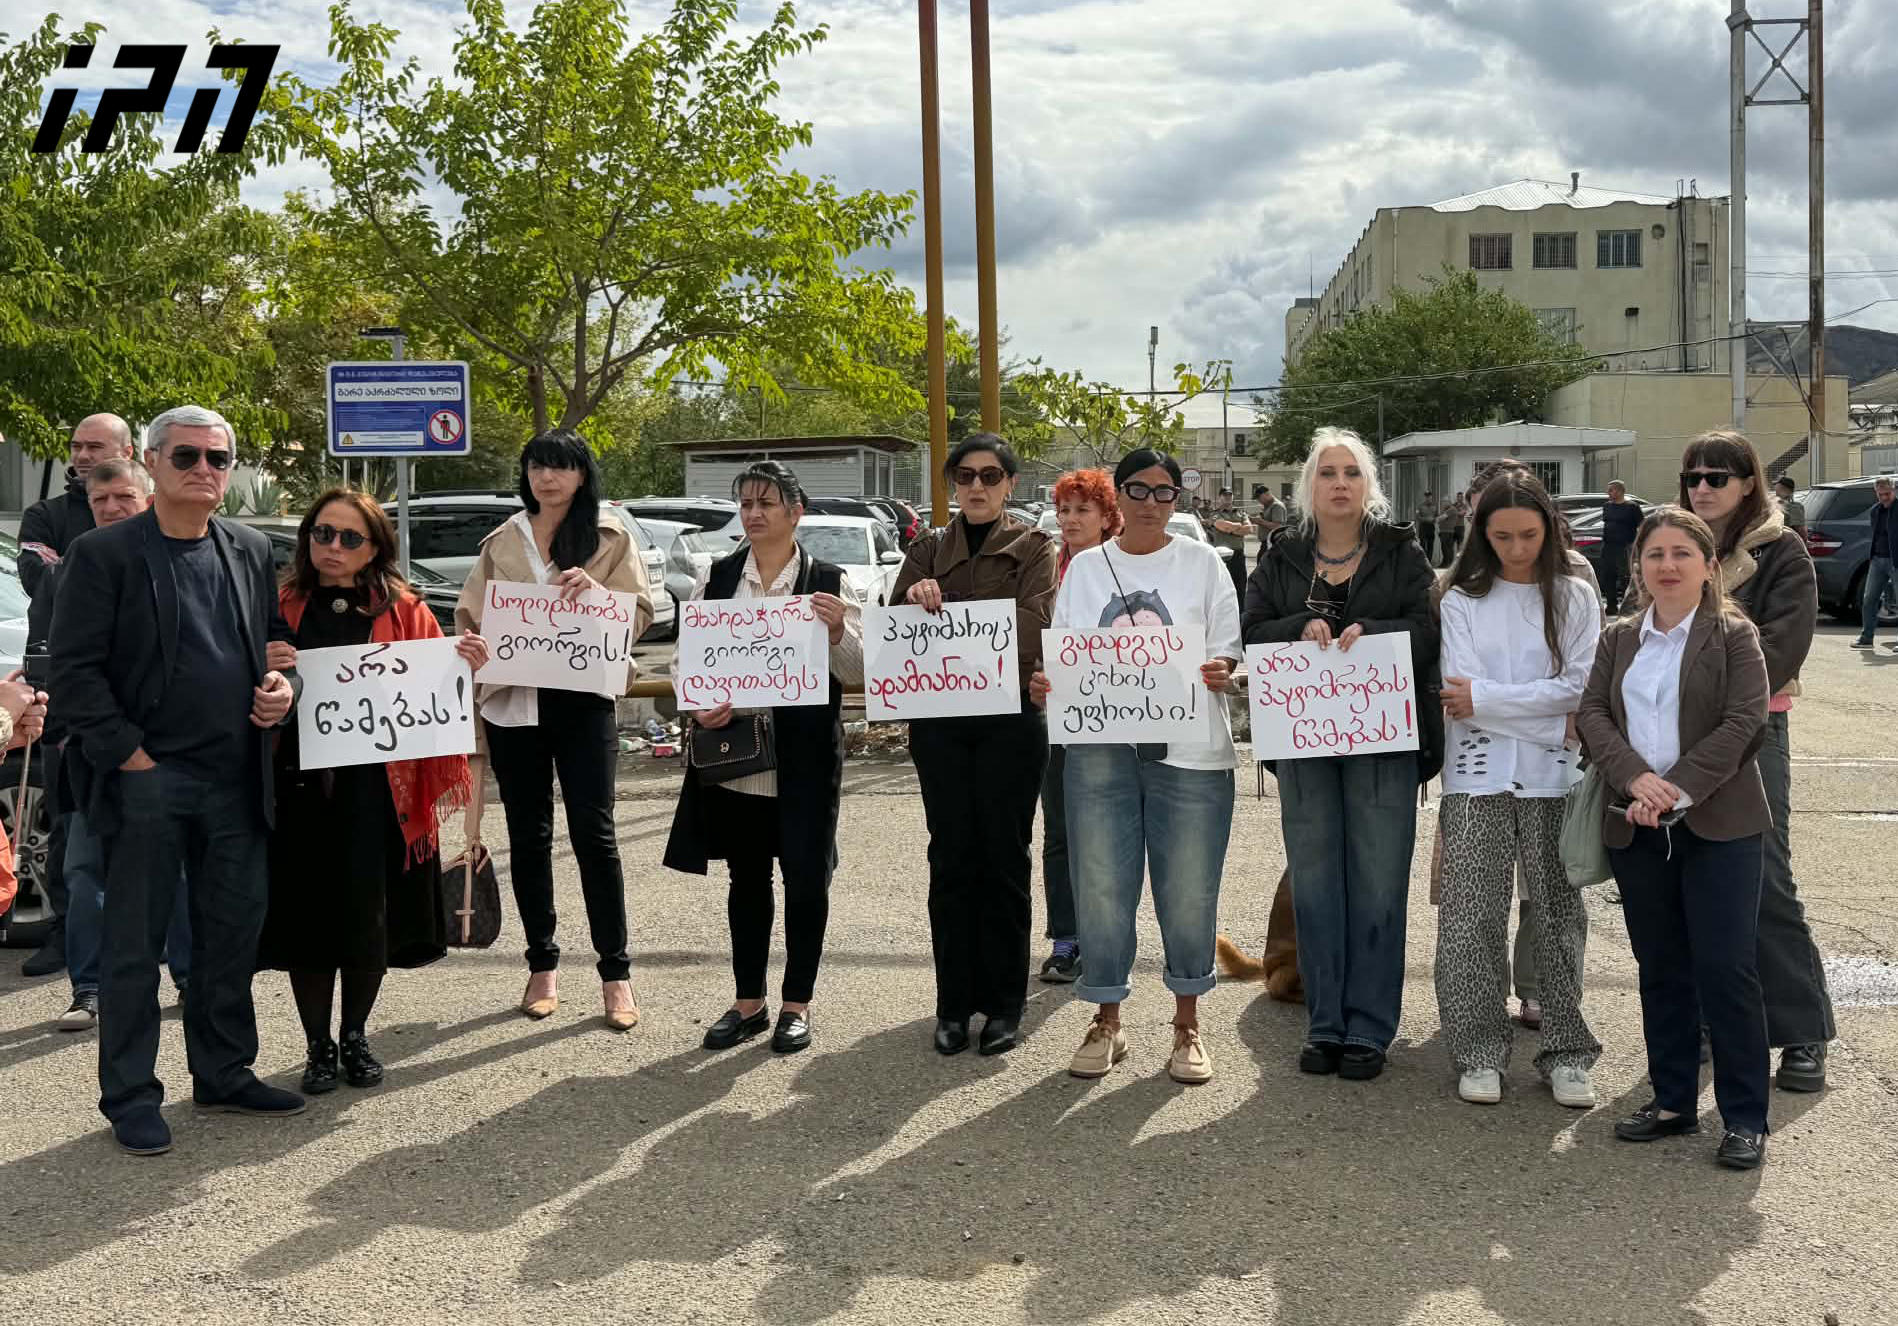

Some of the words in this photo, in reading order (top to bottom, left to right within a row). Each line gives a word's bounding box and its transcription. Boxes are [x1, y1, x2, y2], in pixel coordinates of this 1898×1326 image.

[491, 585, 629, 628] სოლიდარობა
[684, 597, 816, 639] მხარდაჭერა
[497, 627, 630, 670] გიორგის!
[883, 608, 1012, 655] პატიმარიც
[1060, 628, 1185, 667] გადადგეს
[336, 643, 409, 683] არა
[704, 636, 795, 670] გიორგი
[1256, 641, 1310, 675] არა
[682, 663, 818, 705] დავითაძეს
[1079, 664, 1156, 696] ციხის
[1259, 663, 1408, 718] პატიმრების
[315, 675, 468, 751] წამებას!
[1063, 682, 1197, 733] უფროსი!
[1292, 699, 1413, 755] წამებას!
